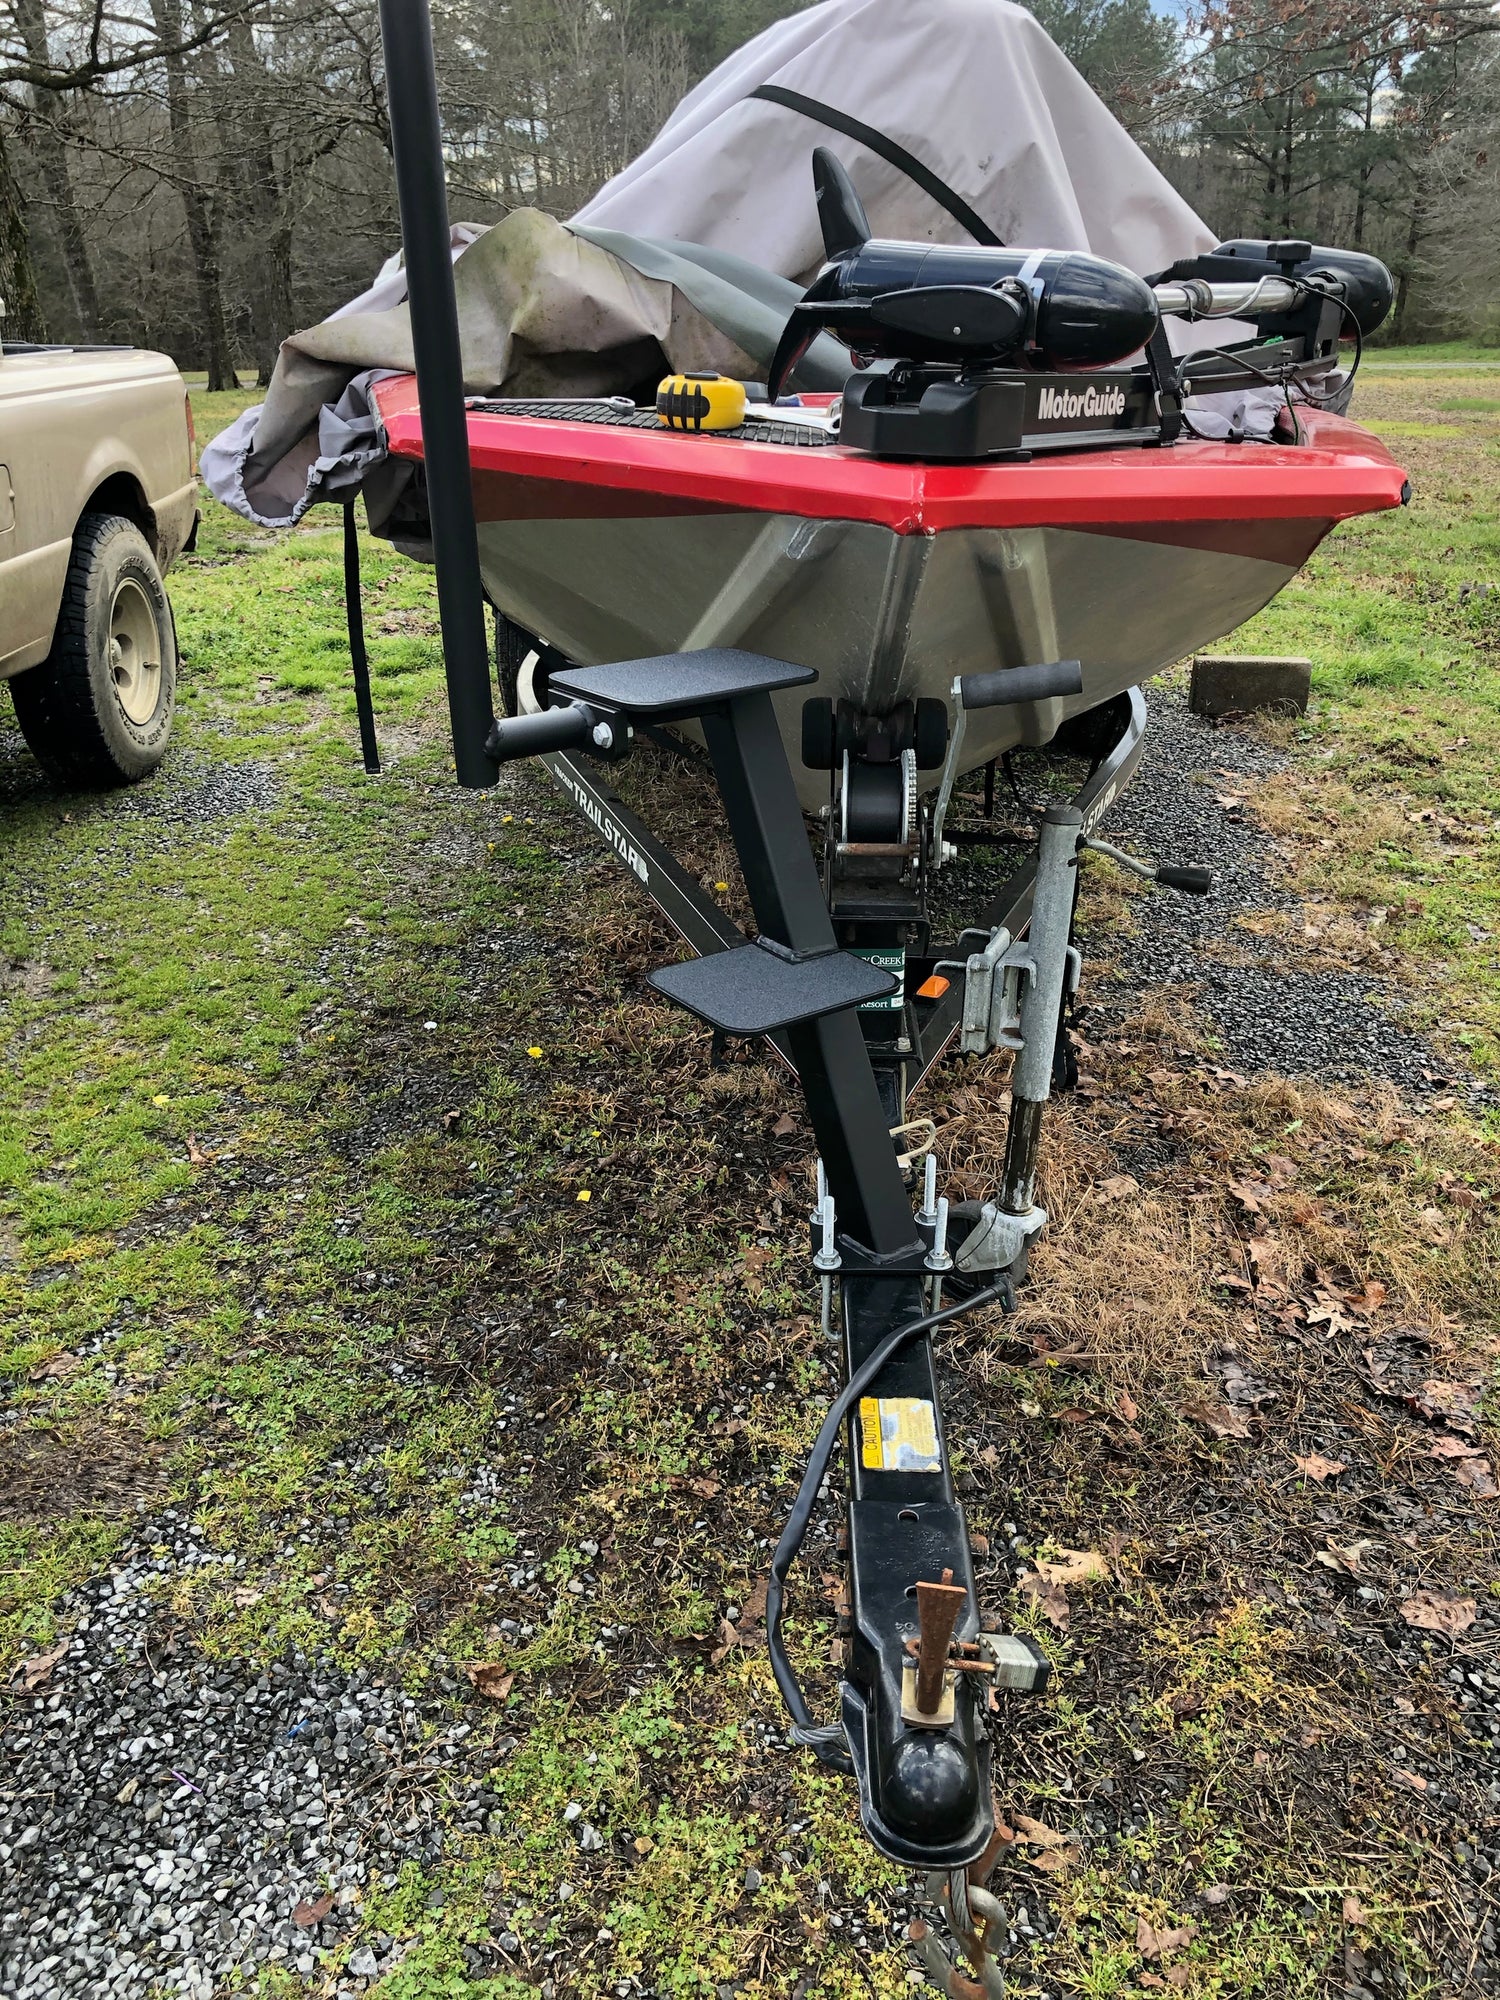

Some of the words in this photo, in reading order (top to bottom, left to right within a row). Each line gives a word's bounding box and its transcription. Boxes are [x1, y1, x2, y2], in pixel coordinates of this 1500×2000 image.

[1038, 386, 1125, 419] MotorGuide
[573, 780, 639, 872] TRAILSTAR
[870, 955, 902, 966] CREEK
[863, 1413, 878, 1451] CAUTION
